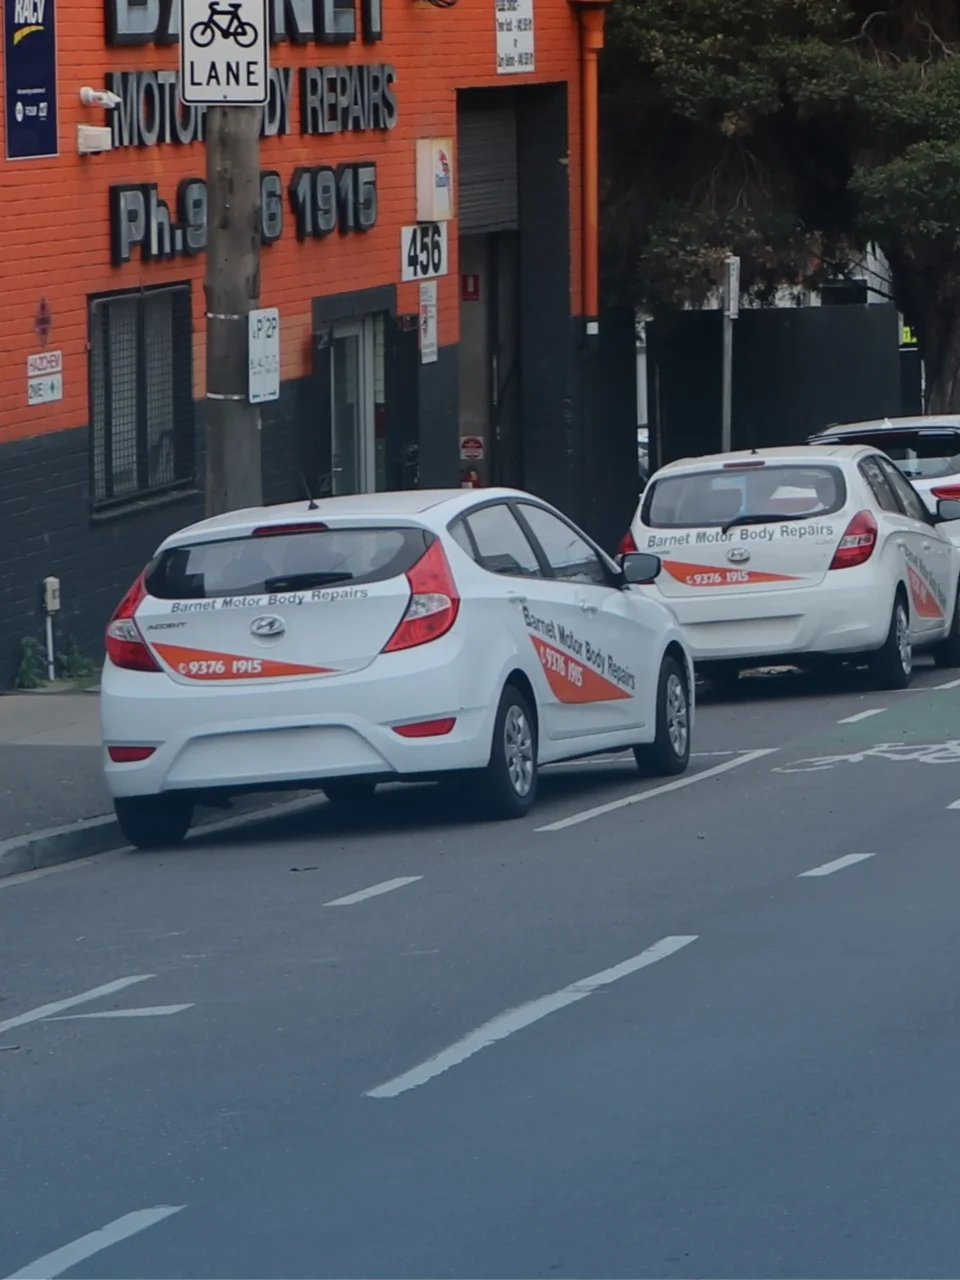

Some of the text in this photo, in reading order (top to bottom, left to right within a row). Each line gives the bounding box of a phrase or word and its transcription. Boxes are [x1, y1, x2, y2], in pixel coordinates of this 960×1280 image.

[190, 61, 259, 87] LANE
[303, 64, 398, 135] REPAIRS
[289, 162, 377, 241] 1915
[407, 222, 441, 276] 456
[266, 317, 277, 338] 2P
[648, 523, 834, 548] Barnet Motor Body Repairs
[694, 571, 749, 585] 9376 1915
[170, 587, 369, 614] Barnet Motor Body Repairs
[522, 605, 635, 690] Barnet Motor Body Repairs
[188, 659, 262, 675] 9376 1915
[545, 647, 583, 687] 9376 1915
